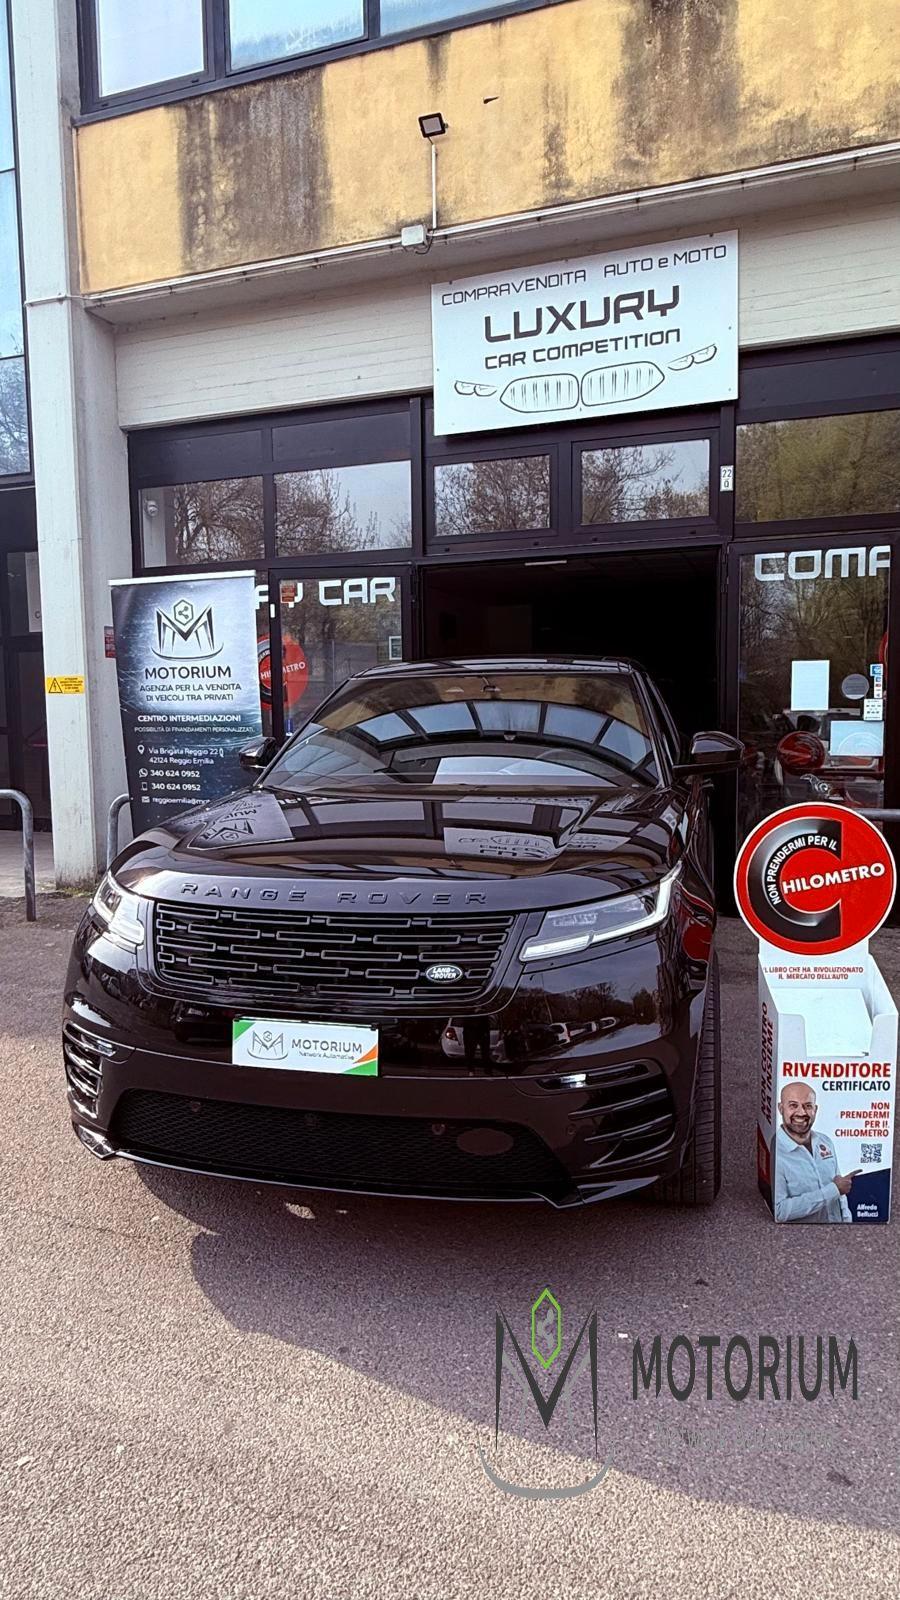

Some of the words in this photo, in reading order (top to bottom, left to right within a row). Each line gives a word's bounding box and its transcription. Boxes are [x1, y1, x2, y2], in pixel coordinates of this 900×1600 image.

[441, 269, 587, 306] COMPRAVENDITA
[604, 257, 653, 278] AUTO
[658, 257, 669, 268] e
[673, 245, 726, 265] MOTO
[484, 285, 680, 343] LUXURY
[485, 351, 526, 370] CAR
[533, 328, 681, 362] COMPETITION
[318, 577, 396, 606] CAR
[145, 665, 232, 680] MOTORIUM
[175, 684, 191, 692] PER
[205, 683, 242, 691] VENDITA
[204, 693, 234, 701] PRIVATI
[169, 714, 241, 722] INTERMEDIAZIONI
[159, 747, 184, 756] Brigata
[184, 748, 208, 756] Reggio
[169, 757, 192, 765] Reggio
[193, 757, 214, 765] Emilia
[150, 769, 164, 777] 340
[165, 769, 180, 777] 624
[151, 782, 165, 790] 340
[182, 783, 201, 791] 0952
[808, 835, 829, 846] PER
[828, 839, 838, 851] IL
[767, 836, 806, 882] PRENDERMI
[180, 882, 308, 903] RANGE
[337, 891, 488, 906] ROVER
[767, 884, 782, 905] NON
[291, 1038, 363, 1054] MOTORIUM
[782, 1062, 892, 1078] RIVENDITORE
[822, 1080, 891, 1091] CERTIFICATO
[871, 1102, 890, 1110] NON
[840, 1111, 890, 1119] PRENDERMI
[864, 1120, 880, 1128] PER
[834, 1129, 889, 1137] CHILOMETRO
